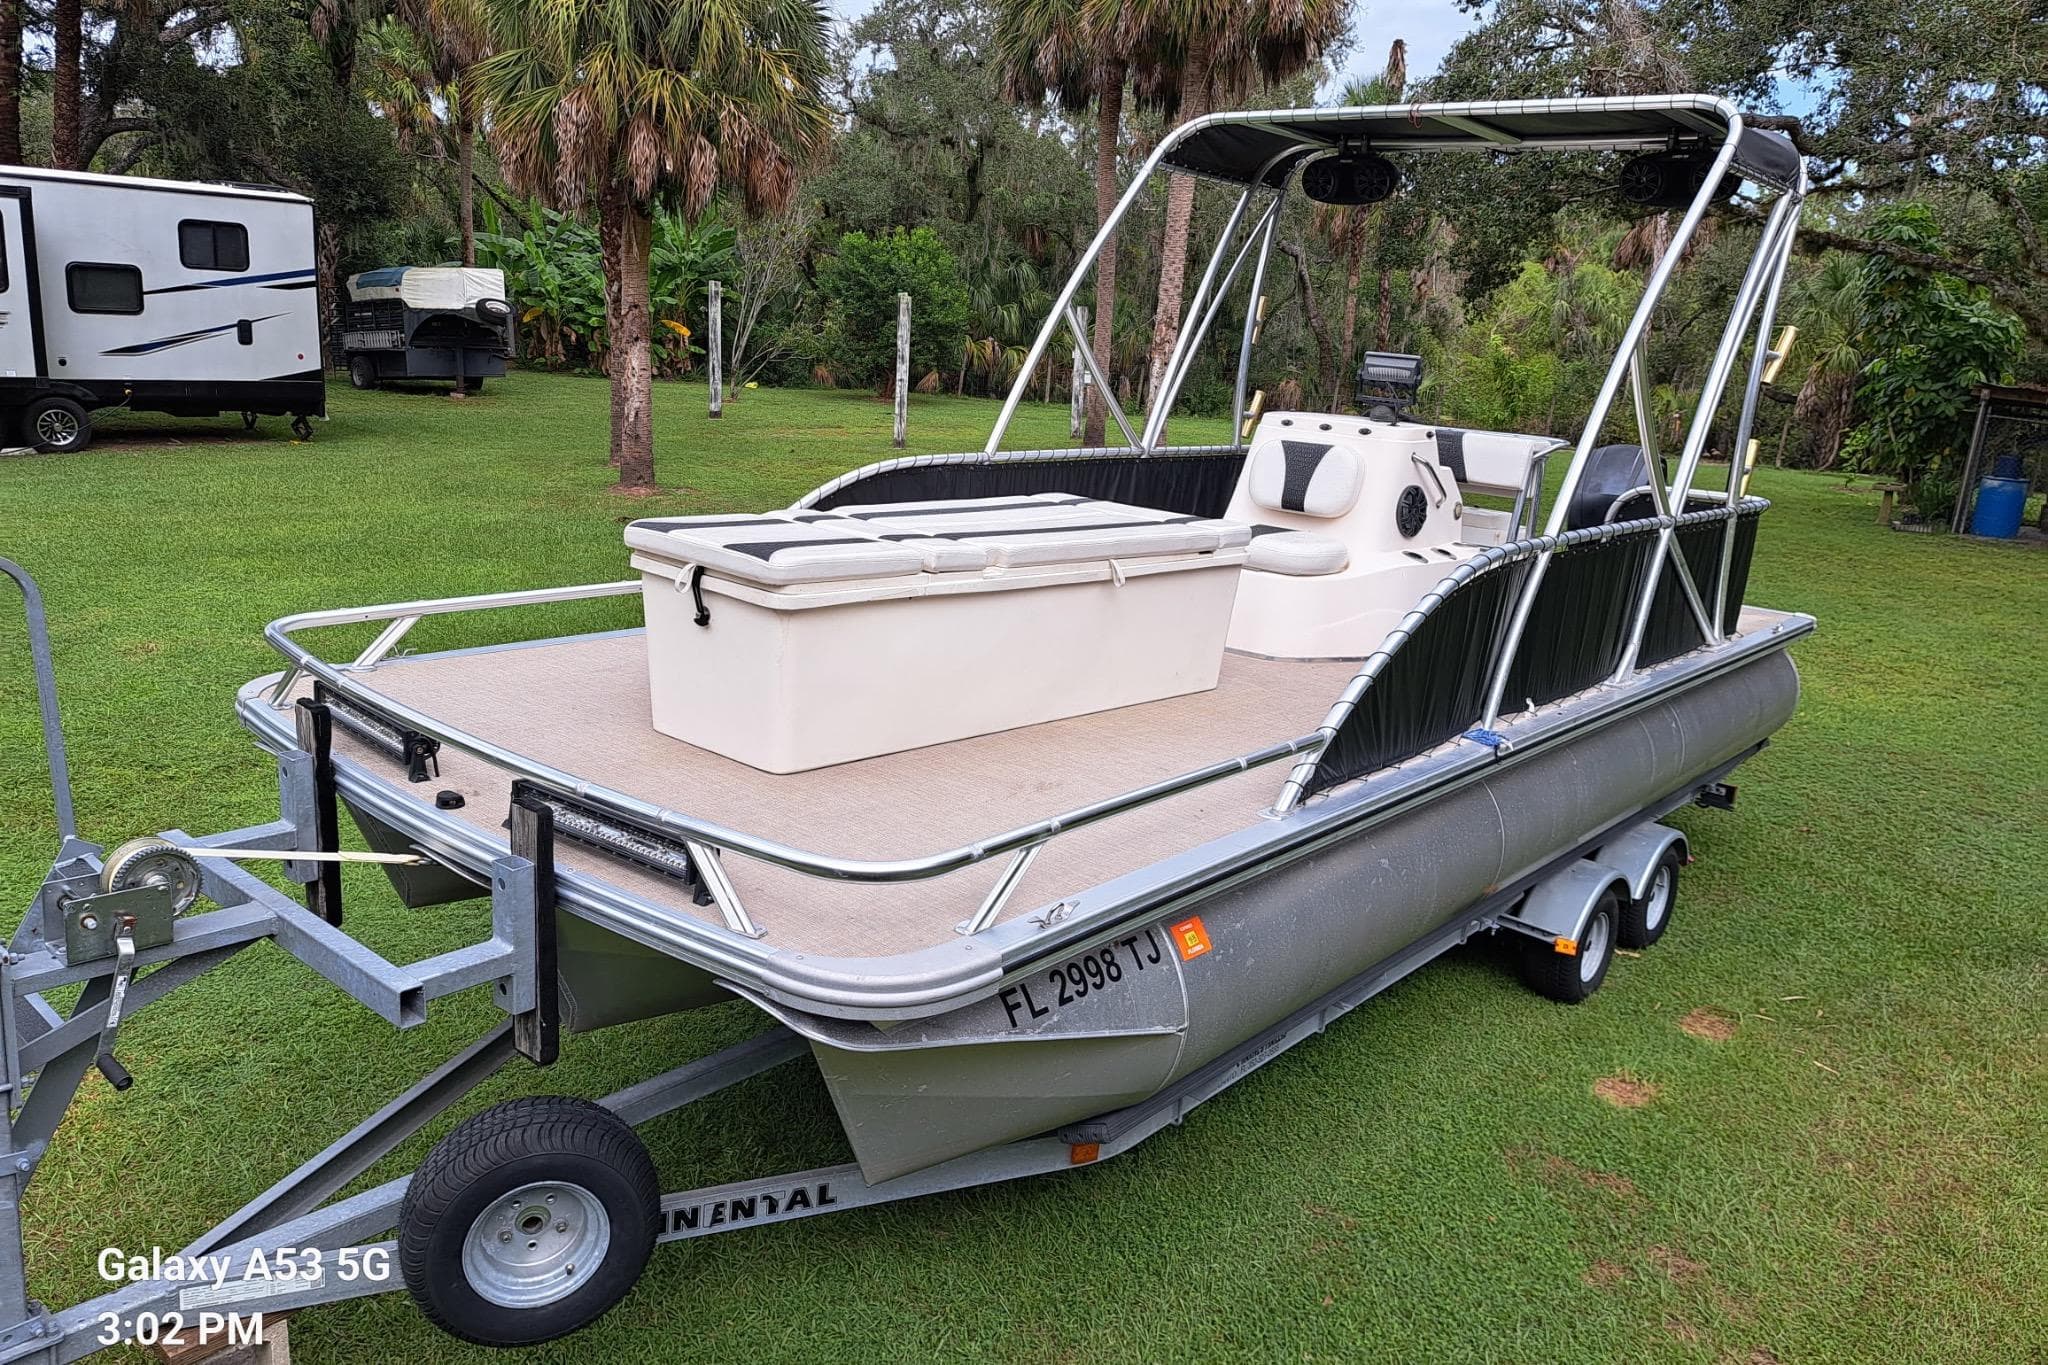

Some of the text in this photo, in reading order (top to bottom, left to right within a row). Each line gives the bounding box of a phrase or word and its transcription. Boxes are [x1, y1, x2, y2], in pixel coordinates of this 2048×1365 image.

[999, 930, 1162, 1028] FL 2998 TJ
[660, 1182, 837, 1234] INENTAL
